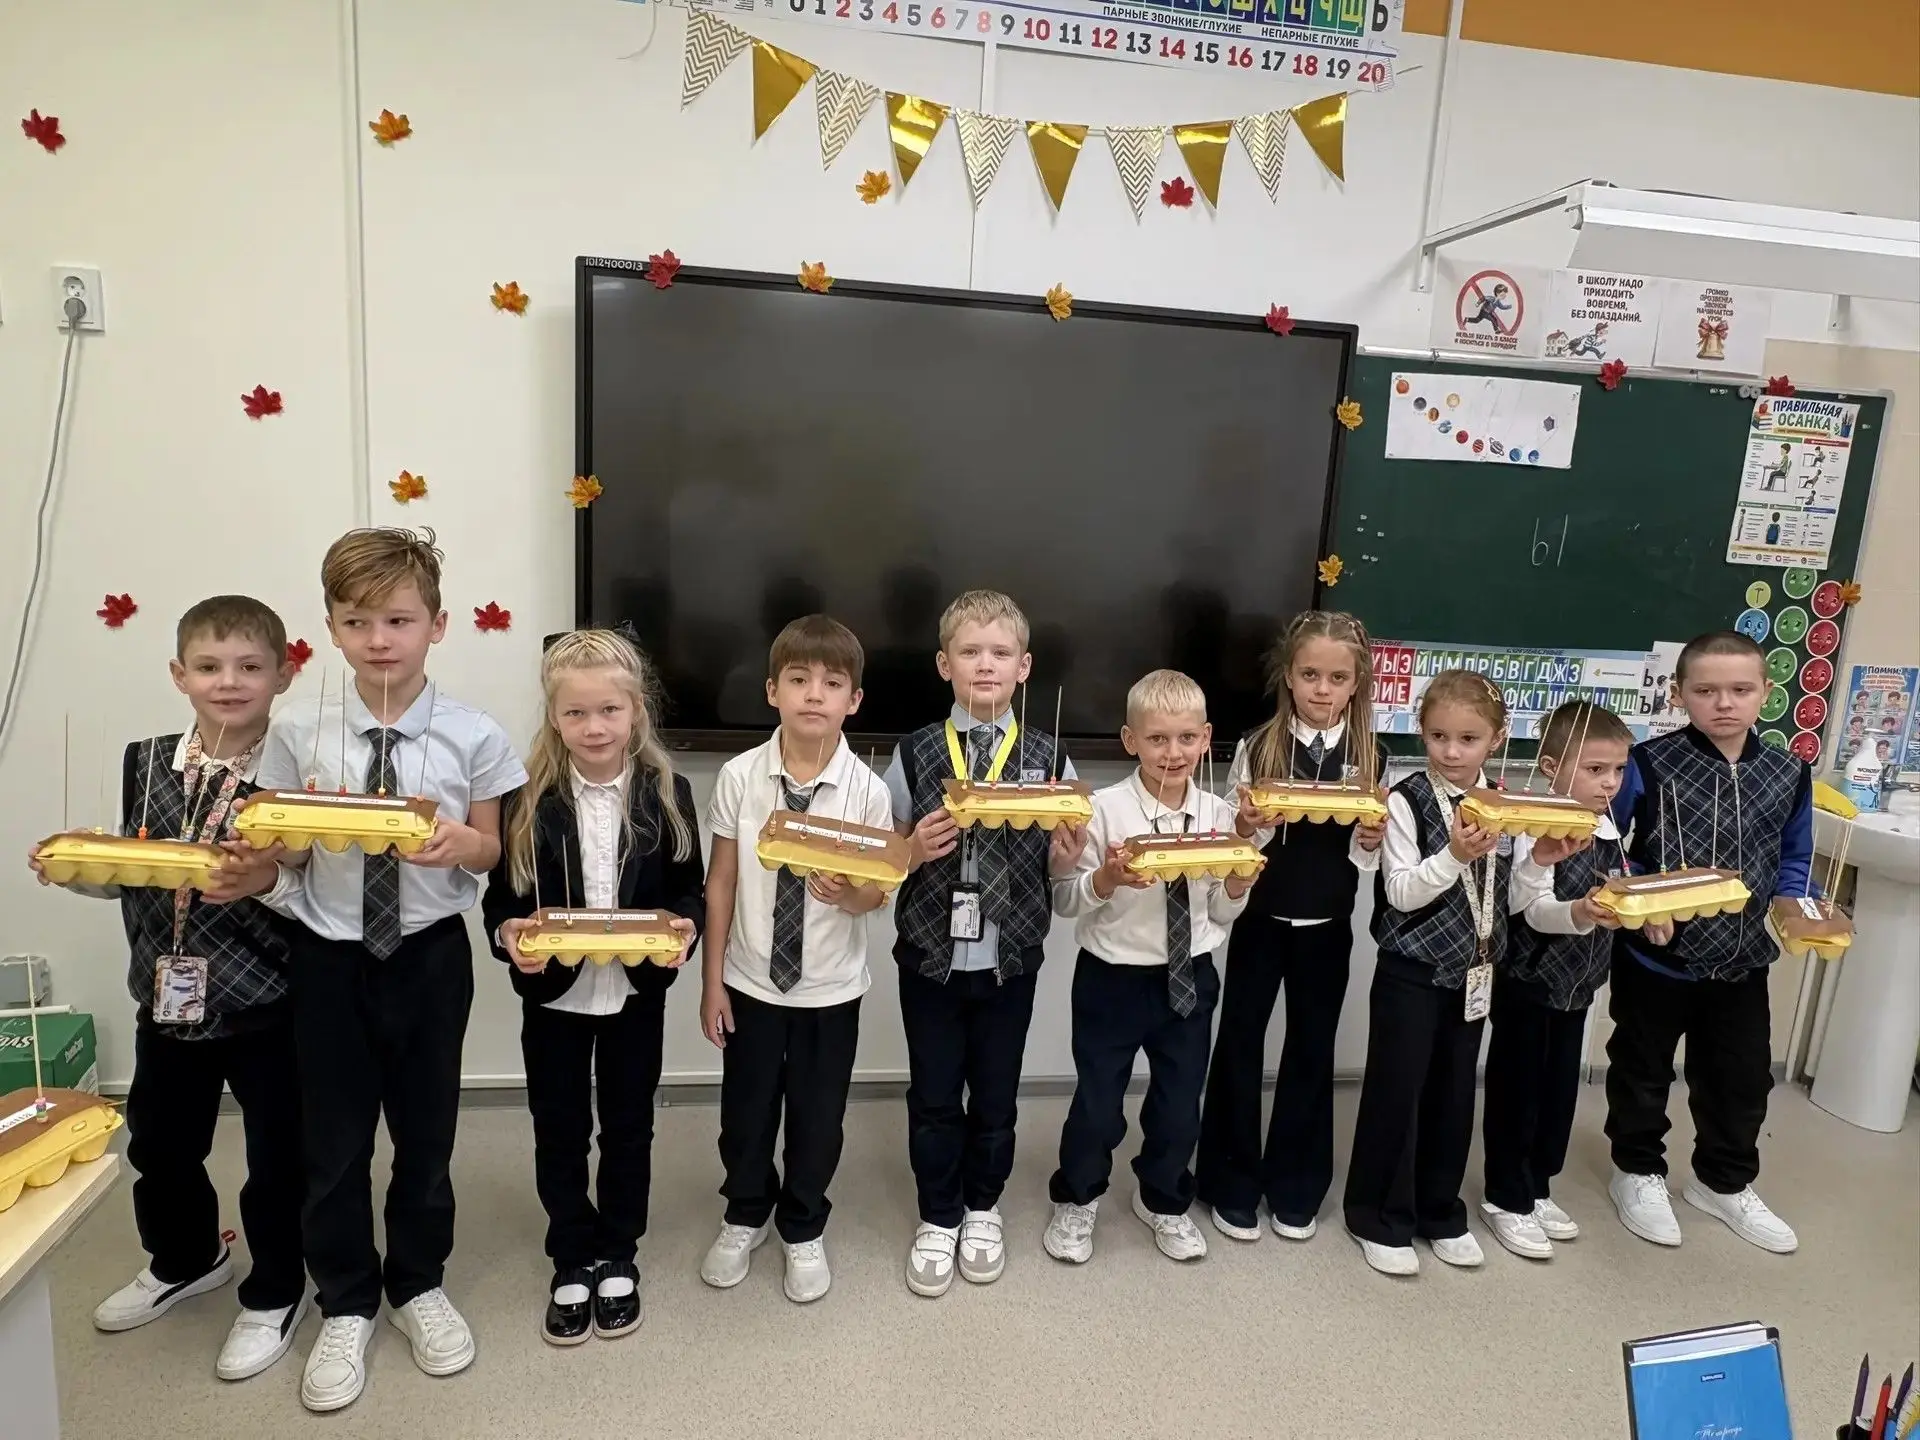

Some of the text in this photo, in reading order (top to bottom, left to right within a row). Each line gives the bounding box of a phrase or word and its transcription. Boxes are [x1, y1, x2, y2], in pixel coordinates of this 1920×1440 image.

[1103, 6, 1149, 21] ПАРНЫЕ
[815, 0, 826, 15] 1
[836, 0, 850, 18] 2
[859, 0, 873, 21] 3
[882, 2, 898, 23] 4
[907, 5, 921, 26] 5
[930, 7, 945, 28] 6
[955, 9, 969, 30] 7
[976, 11, 992, 33] 8
[1001, 14, 1015, 35] 9
[1024, 18, 1050, 41] 10
[1059, 22, 1082, 45] 11
[1091, 27, 1118, 50] 12
[1126, 31, 1151, 55] 13
[1160, 36, 1186, 59] 14
[1194, 41, 1219, 64] 15
[1227, 46, 1253, 68] 16
[1261, 50, 1286, 71] 17
[1293, 54, 1318, 76] 18
[1325, 58, 1351, 79] 19
[1357, 62, 1385, 84] 20
[1261, 27, 1359, 48] НЕПАРНЫЕ ГЛУХИЕ
[585, 257, 643, 271] 1012400013
[1577, 275, 1644, 289] В ШКОЛУ НАДО
[1583, 287, 1635, 300] ПРИХОДИТЬ
[1587, 299, 1628, 311] ВОВРЕМЯ,
[1571, 309, 1587, 319] БЕЗ
[1773, 400, 1844, 418] ПРАВИЛЬНАЯ
[1777, 413, 1831, 430] ОСАНКА
